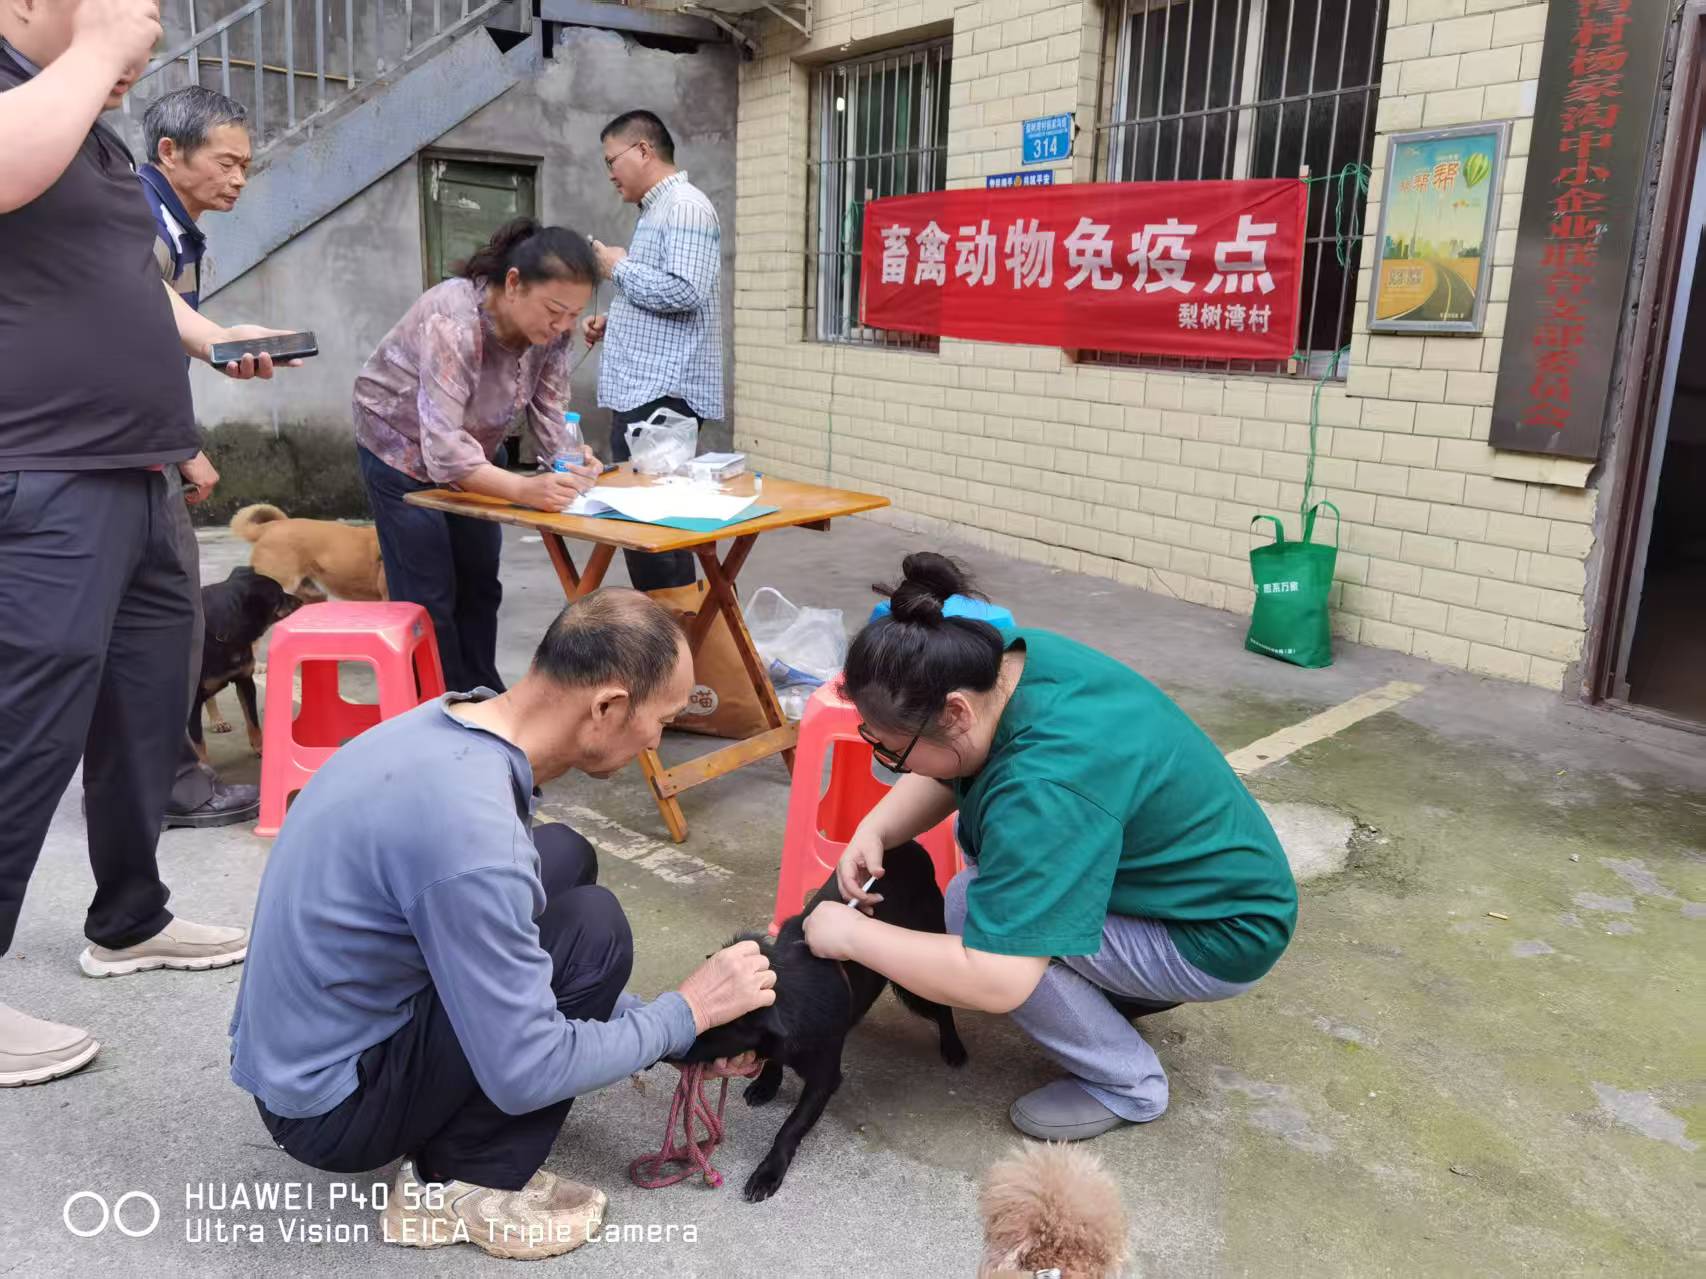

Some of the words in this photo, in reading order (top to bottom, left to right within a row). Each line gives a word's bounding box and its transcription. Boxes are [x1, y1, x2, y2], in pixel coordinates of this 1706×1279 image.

[1033, 136, 1057, 158] 314
[880, 215, 1278, 295] 畜禽动物免疫点
[1178, 303, 1272, 333] 梨树湾村
